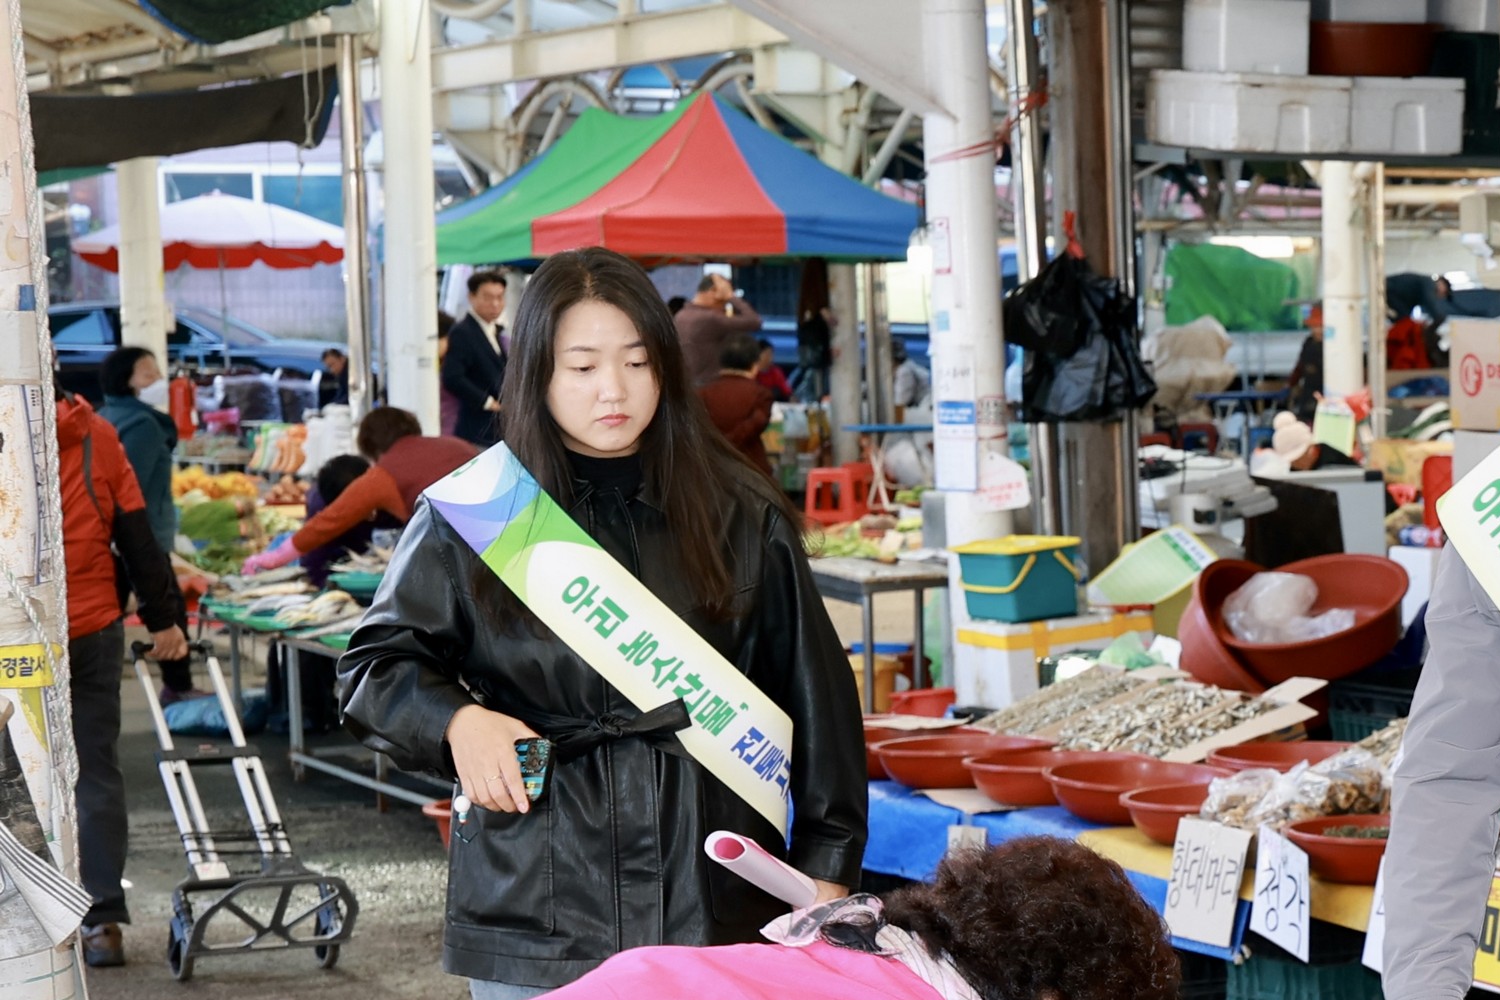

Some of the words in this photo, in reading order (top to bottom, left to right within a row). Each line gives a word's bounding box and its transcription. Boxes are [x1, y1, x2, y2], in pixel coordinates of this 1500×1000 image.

[0, 656, 45, 679] 경찰서
[562, 576, 629, 639] 우리
[617, 630, 748, 736] 농수산물,
[731, 726, 792, 799] 전통시
[1169, 839, 1244, 913] 황태머리
[1259, 860, 1305, 953] 청각
